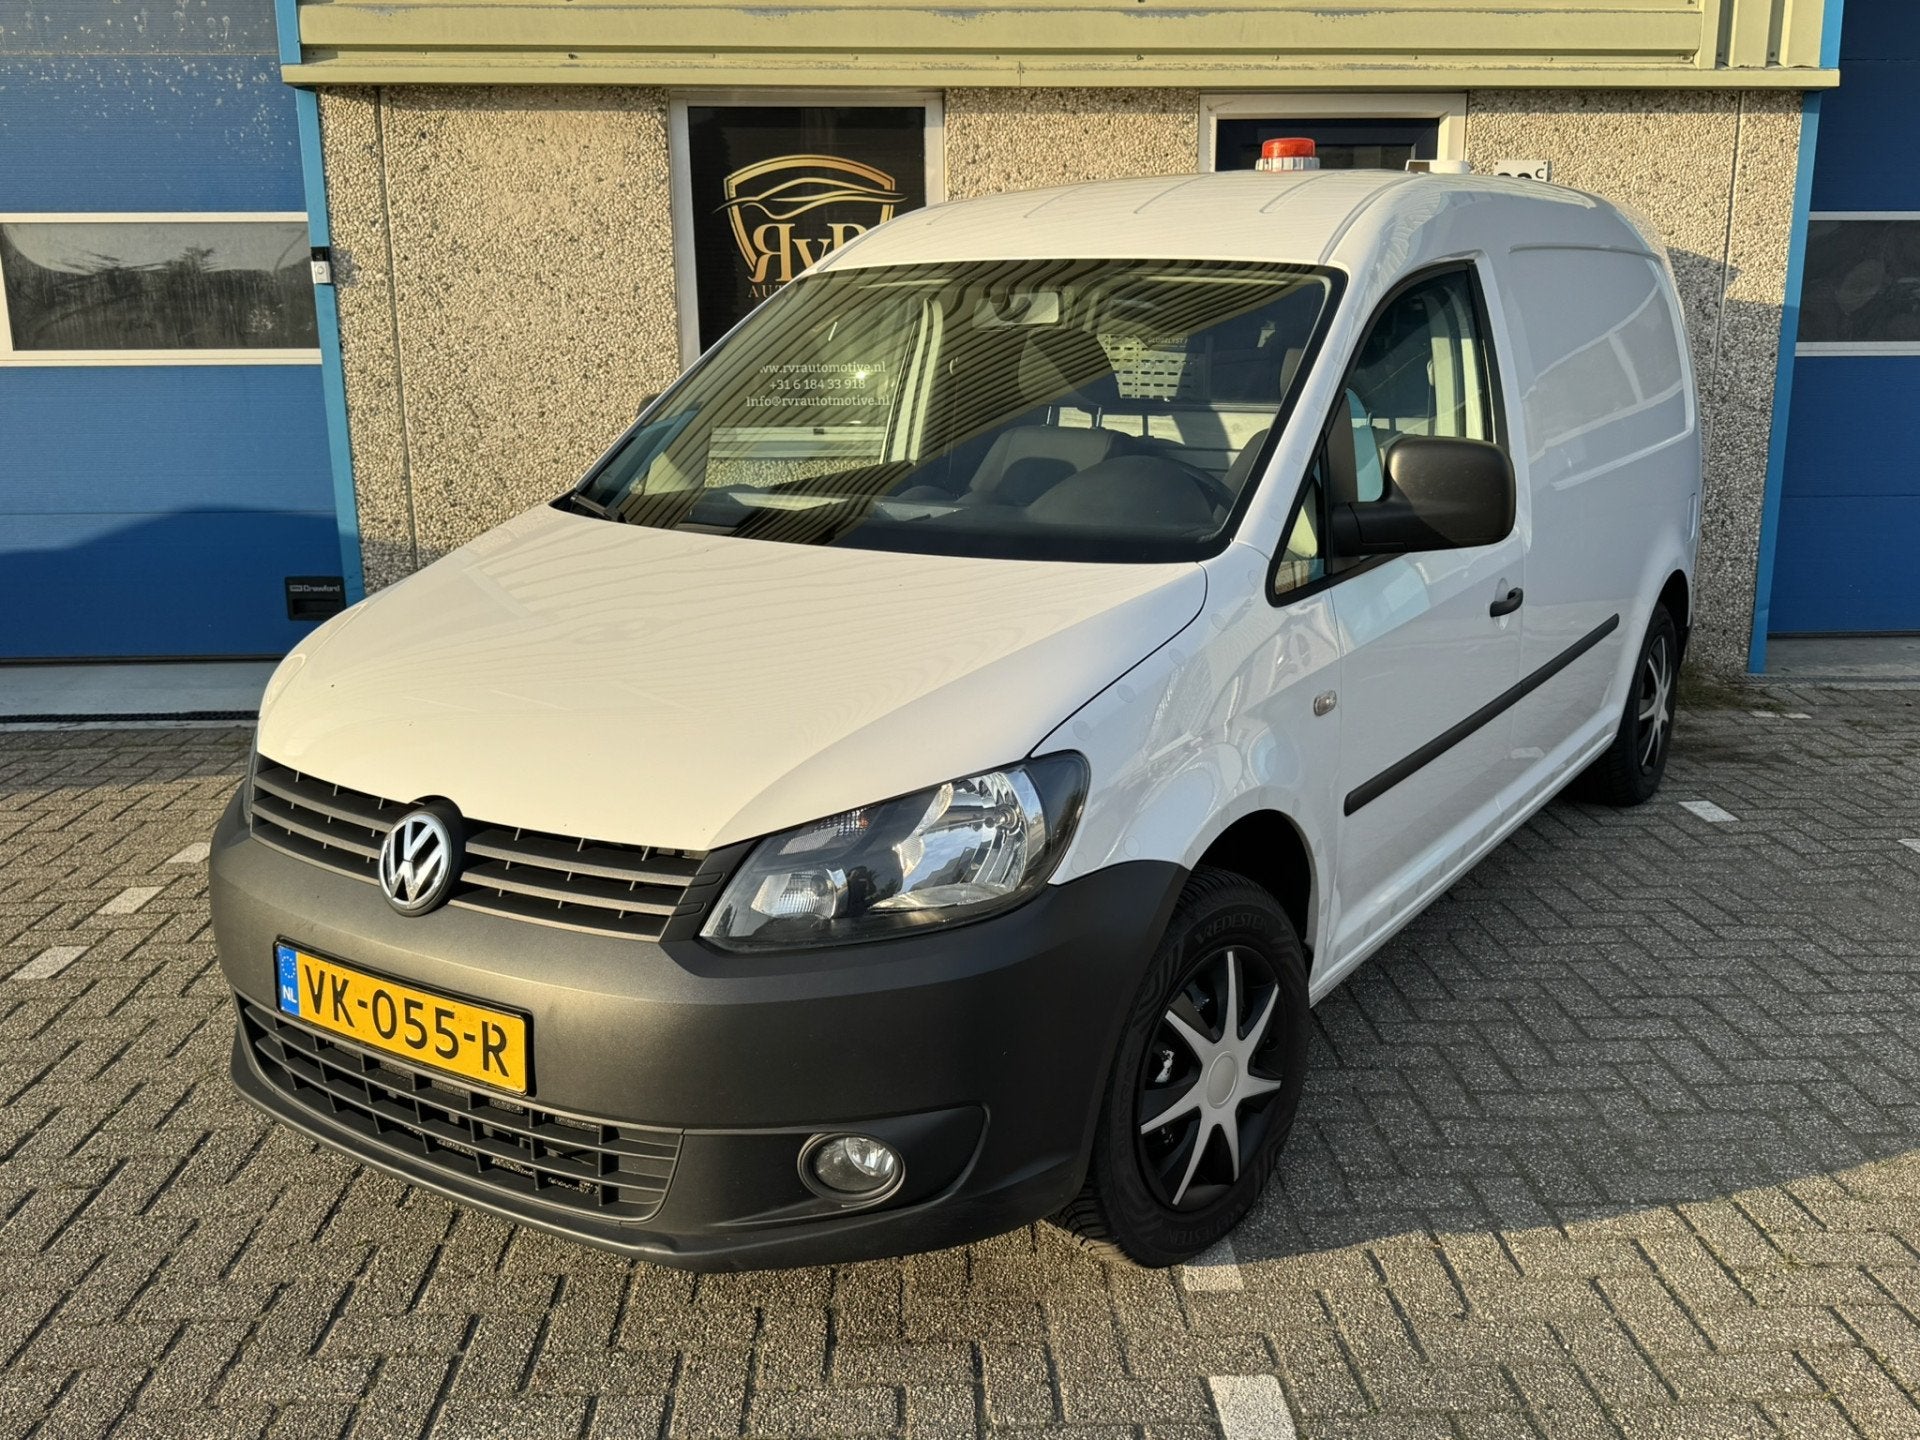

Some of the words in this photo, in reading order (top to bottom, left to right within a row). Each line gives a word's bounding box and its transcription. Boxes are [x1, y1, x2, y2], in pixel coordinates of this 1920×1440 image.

[769, 379, 791, 390] +31
[793, 379, 801, 390] 6
[803, 379, 825, 390] 184
[827, 379, 841, 390] 33
[844, 379, 866, 389] 918
[282, 984, 298, 1004] NL
[304, 964, 510, 1077] VK-055-R
